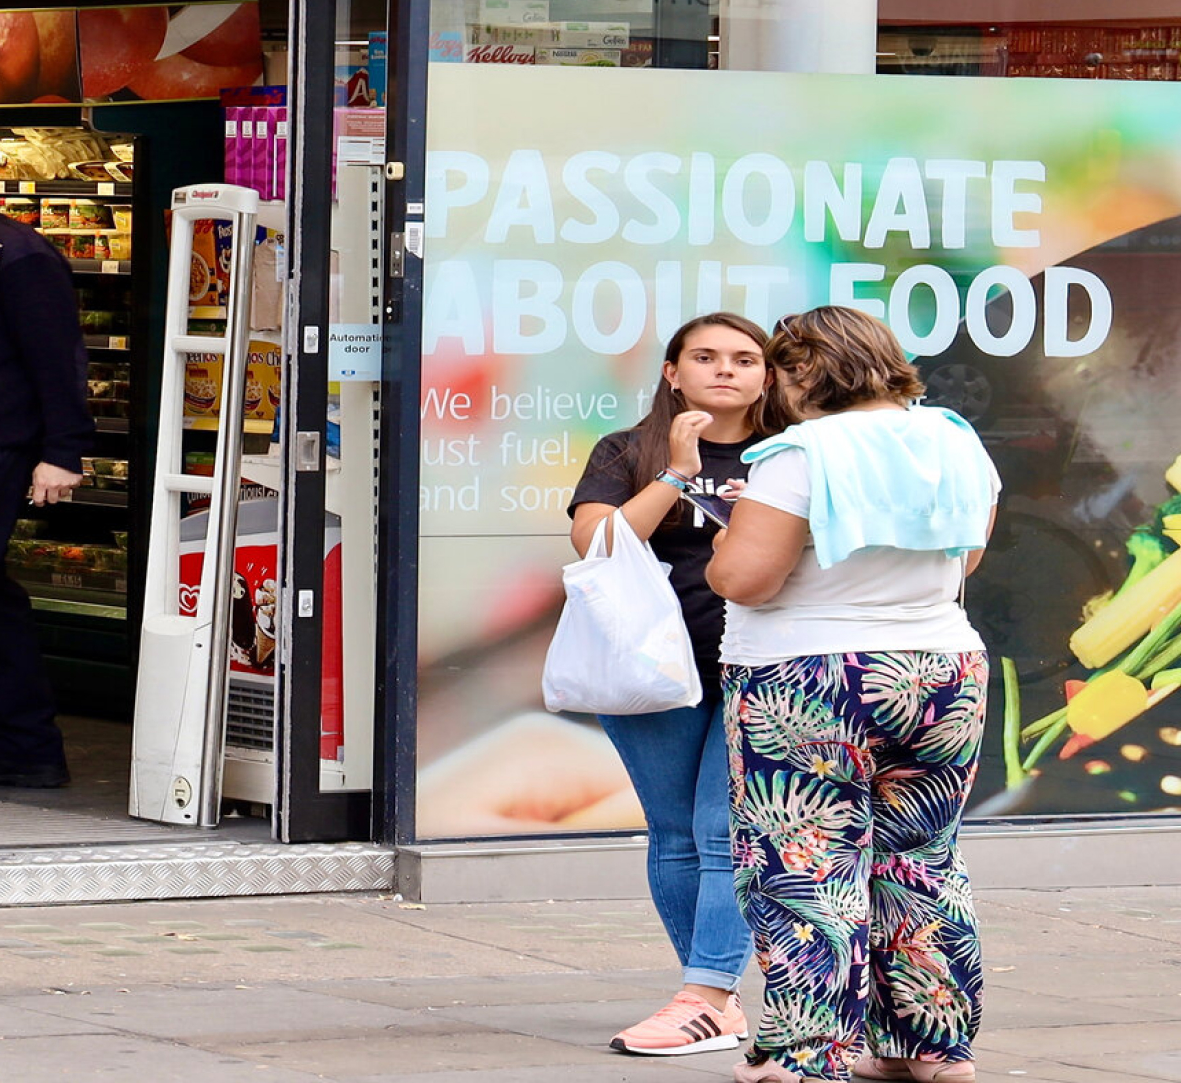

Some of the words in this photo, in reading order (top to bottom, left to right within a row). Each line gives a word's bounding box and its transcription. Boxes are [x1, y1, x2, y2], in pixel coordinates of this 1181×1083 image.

[422, 149, 1046, 249] PASSIONATE
[422, 259, 791, 356] ABOUT
[344, 344, 370, 353] door
[420, 387, 471, 420] We
[491, 385, 618, 420] believe
[423, 433, 481, 467] ust
[499, 431, 577, 467] fuel.
[419, 476, 480, 513] and
[500, 486, 575, 513] som
